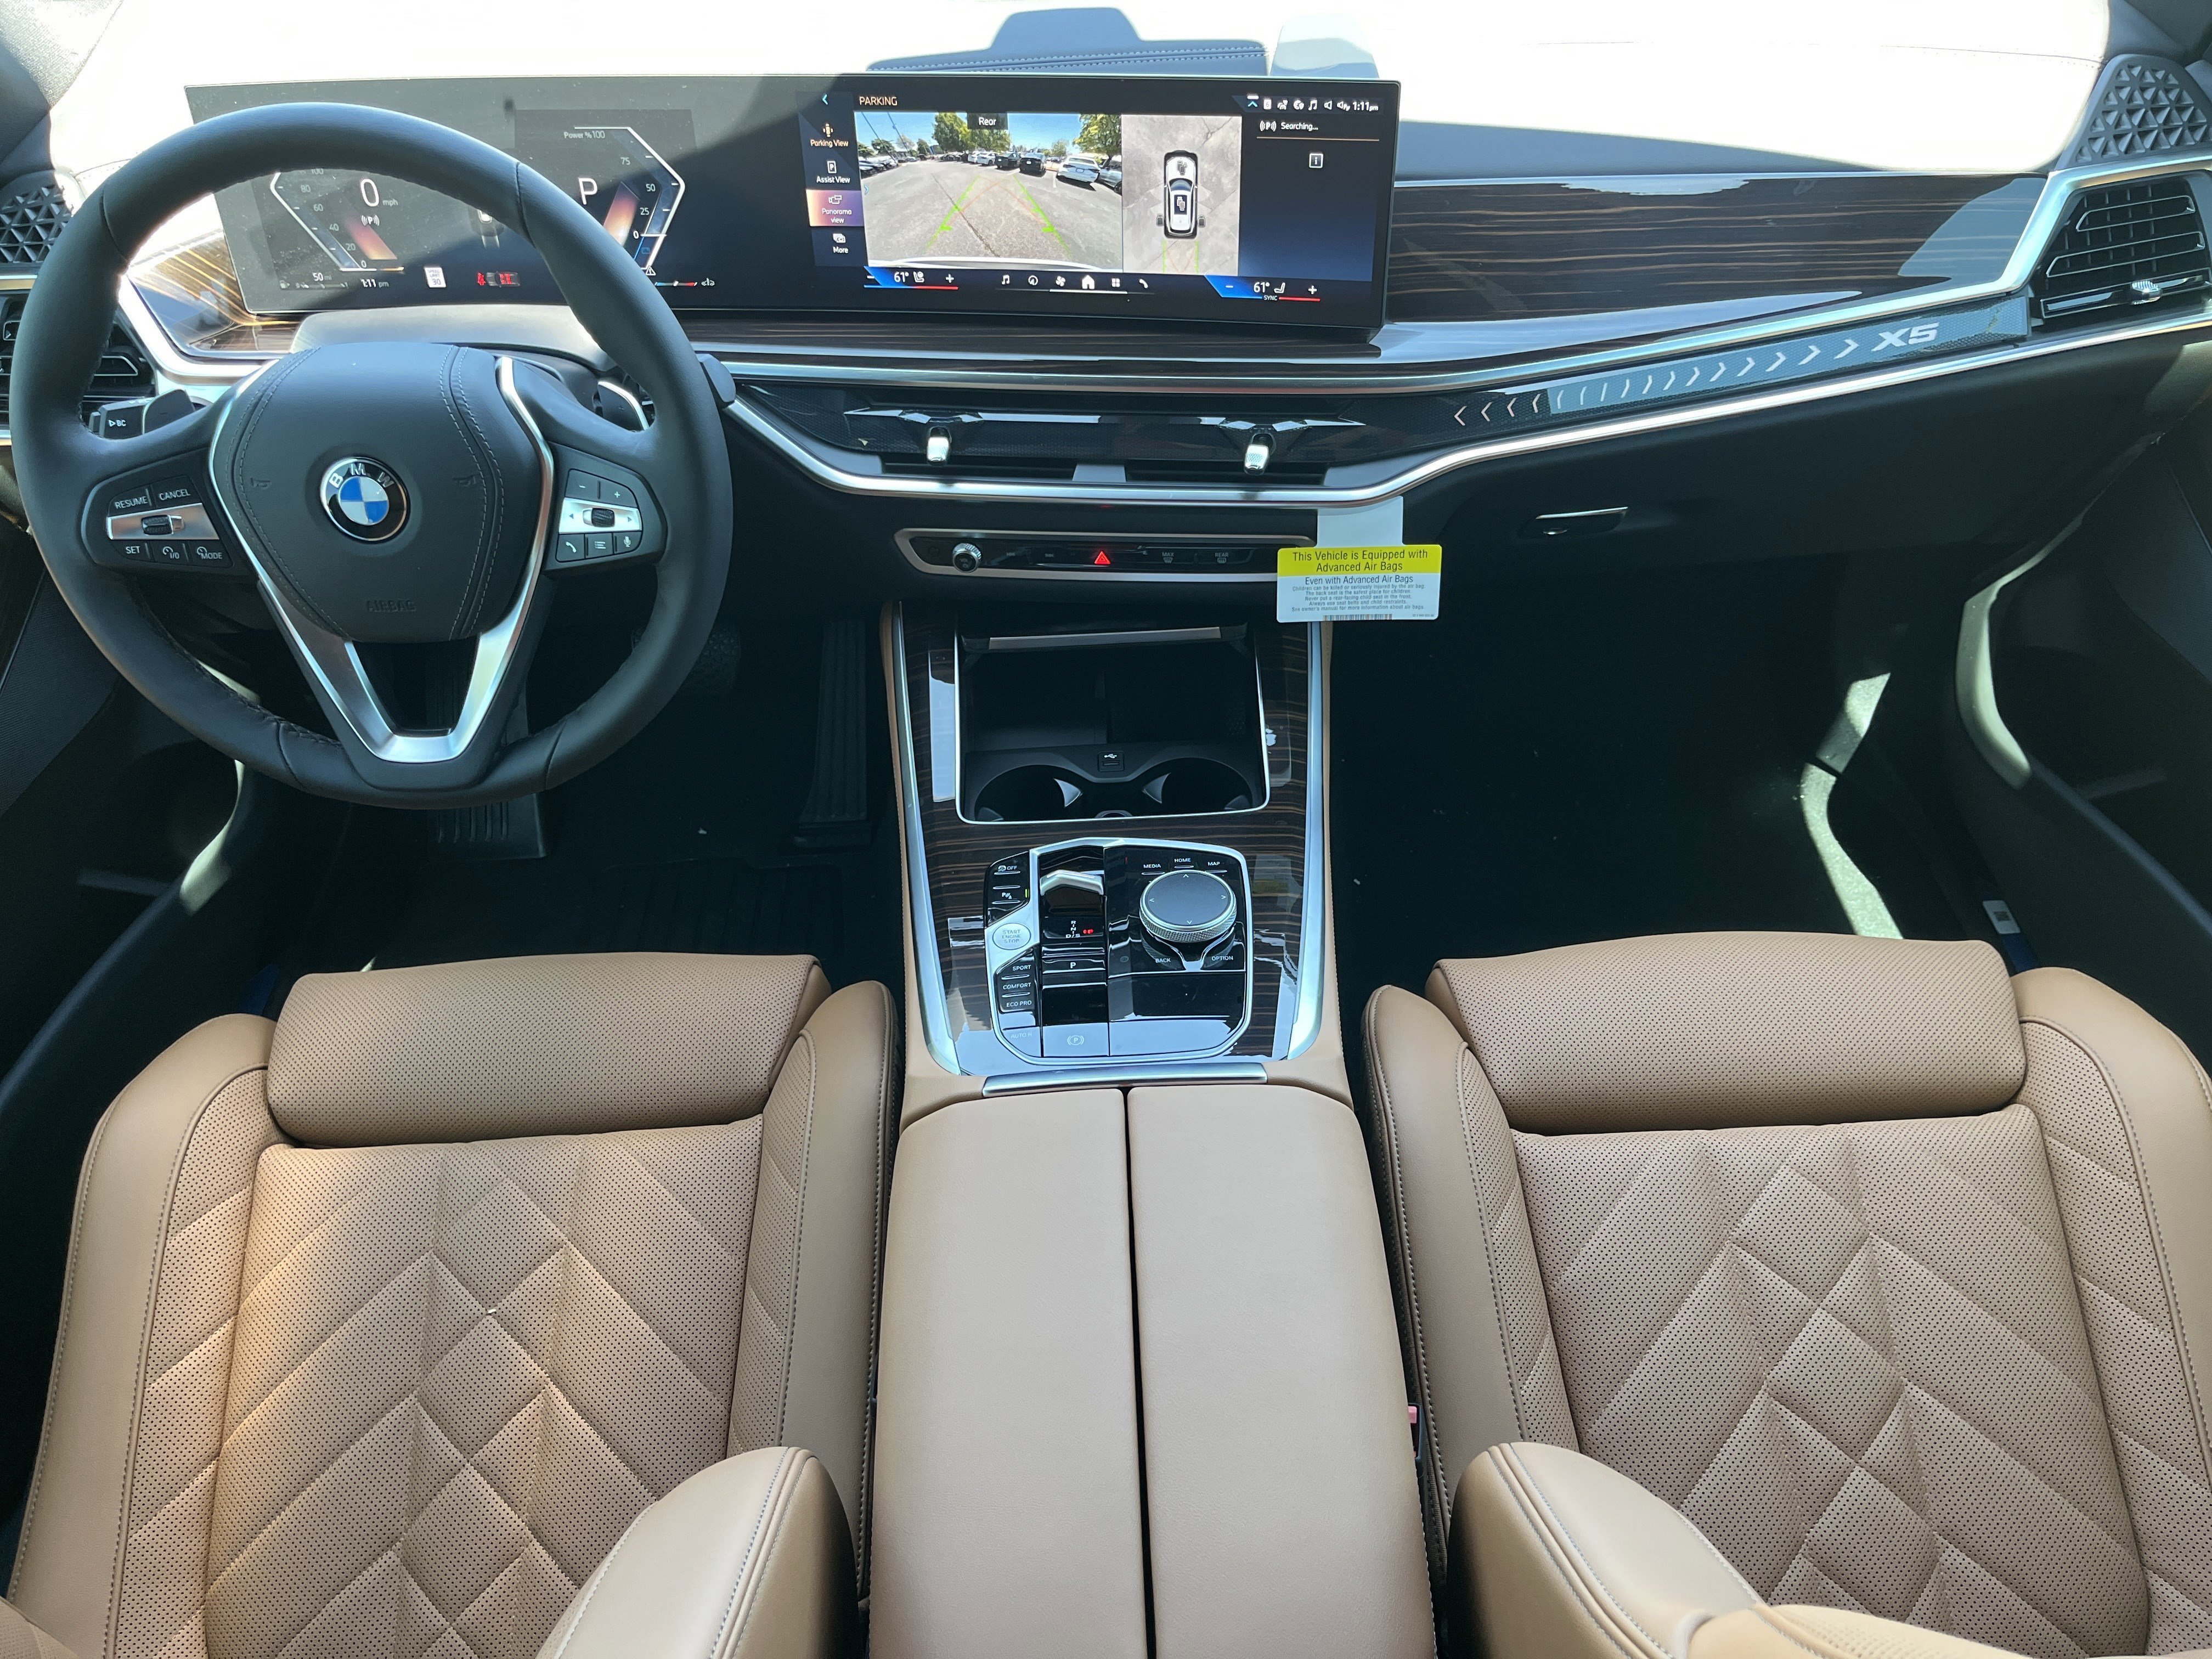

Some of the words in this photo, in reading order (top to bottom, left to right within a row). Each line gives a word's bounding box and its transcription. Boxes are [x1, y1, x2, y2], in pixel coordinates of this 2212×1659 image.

[859, 96, 898, 106] PARKING
[978, 117, 997, 126] Rear
[1280, 121, 1318, 132] Searching...
[810, 139, 833, 148] Parking
[620, 157, 631, 165] 75
[300, 184, 311, 193] 80
[578, 177, 598, 205] P
[645, 183, 656, 192] 50
[360, 178, 380, 207] 0
[382, 199, 399, 207] mph
[313, 203, 324, 212] 60
[640, 207, 650, 216] 25
[329, 223, 340, 232] 40
[633, 230, 639, 239] 0
[360, 259, 367, 268] 0
[312, 272, 324, 281] 50
[360, 278, 376, 287] 1:11
[1871, 321, 1939, 352] X5
[329, 462, 395, 488] BMW
[159, 488, 191, 501] CANCEL
[114, 496, 148, 509] RESUME
[125, 546, 140, 554] SET
[1293, 552, 1312, 561] This
[1315, 550, 1348, 561] Vehicle
[1351, 550, 1358, 560] is
[1362, 549, 1405, 561] Equipped
[1408, 549, 1428, 558] with
[1316, 562, 1361, 572] Advanced
[1364, 561, 1377, 571] Air
[1380, 561, 1403, 572] Bags
[1305, 577, 1323, 585] Even
[1325, 576, 1341, 584] with
[1343, 575, 1379, 584] Advanced
[1395, 574, 1414, 584] Bags
